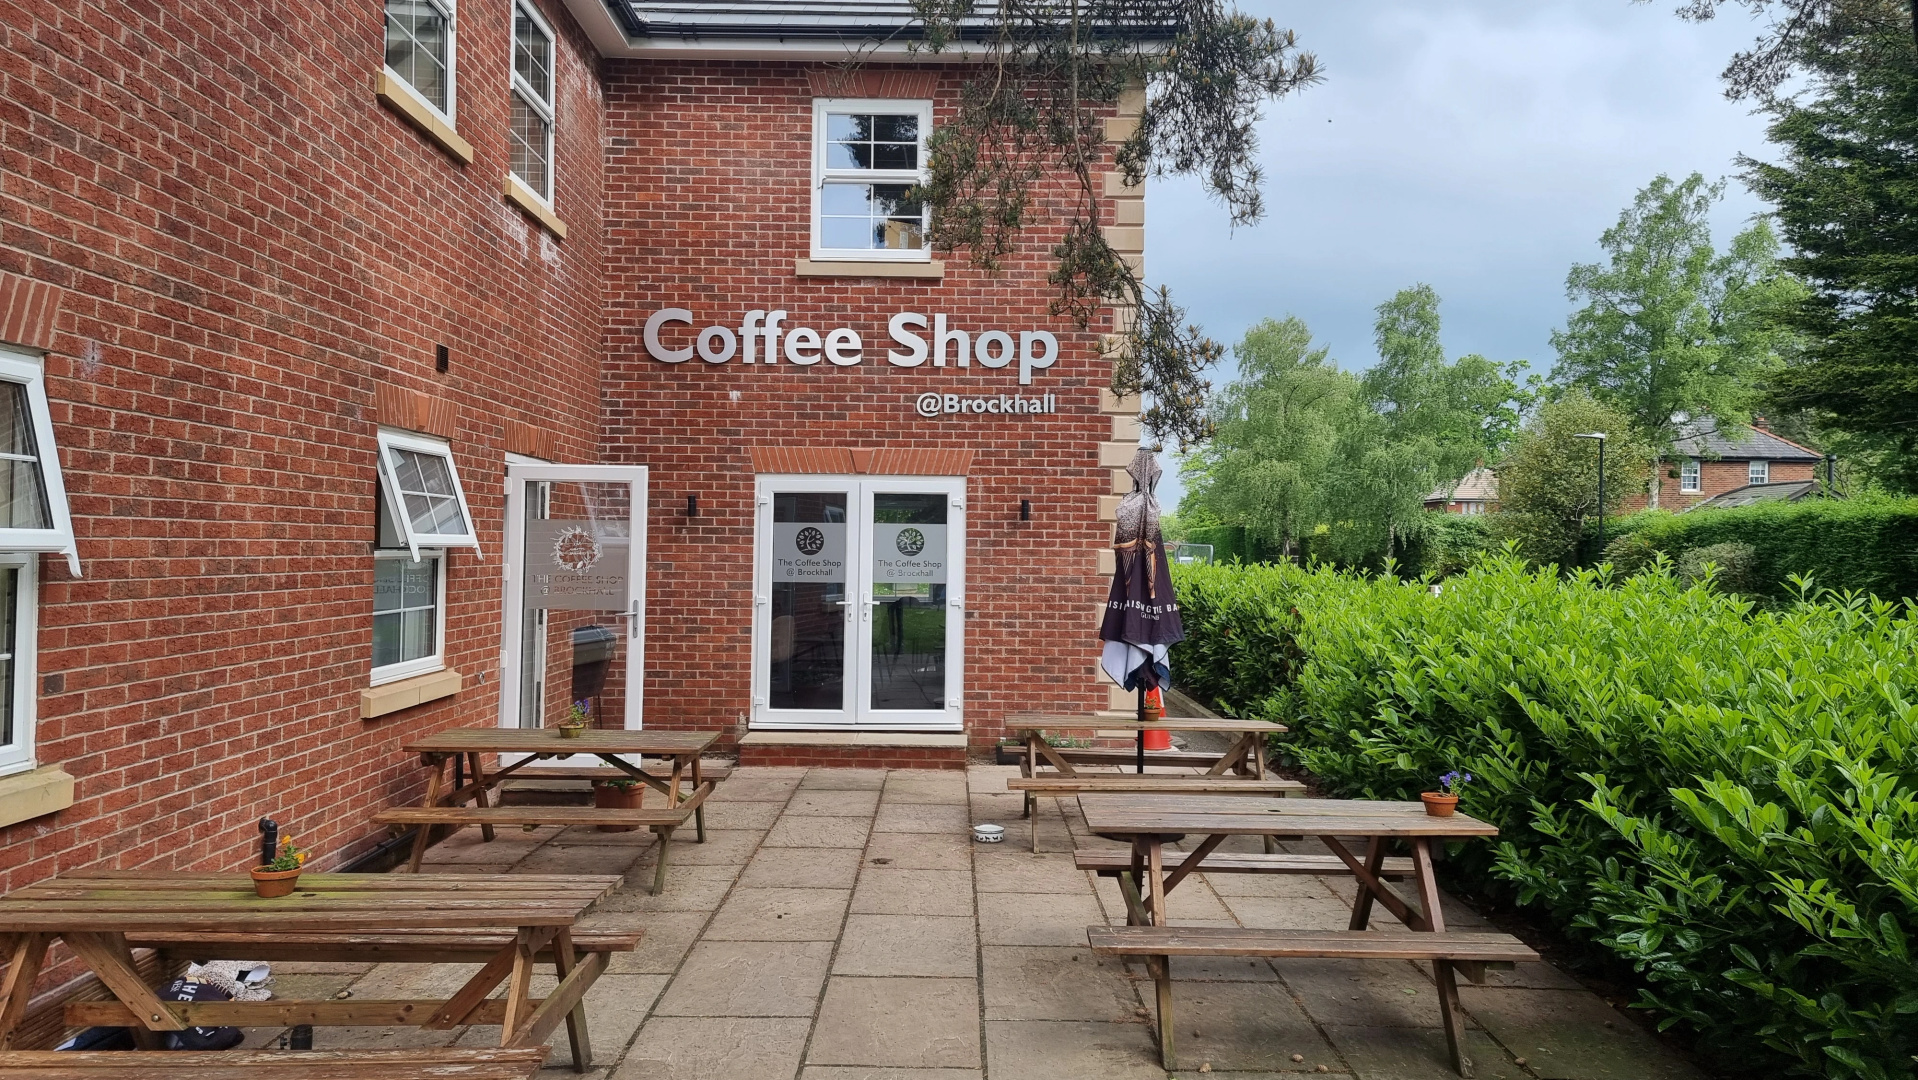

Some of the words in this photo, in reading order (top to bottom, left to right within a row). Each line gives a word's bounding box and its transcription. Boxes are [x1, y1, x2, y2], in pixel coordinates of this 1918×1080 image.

[643, 308, 862, 366] Coffee
[887, 312, 1059, 385] Shop
[916, 392, 1056, 417] @Brockhall
[823, 559, 842, 568] Shop
[923, 560, 942, 569] Shop
[786, 568, 795, 577] @
[886, 569, 895, 577] @
[898, 569, 934, 577] Brockhall
[532, 574, 551, 584] THE
[554, 574, 593, 584] COFFEE
[596, 575, 624, 585] SHOP
[540, 585, 550, 596] @
